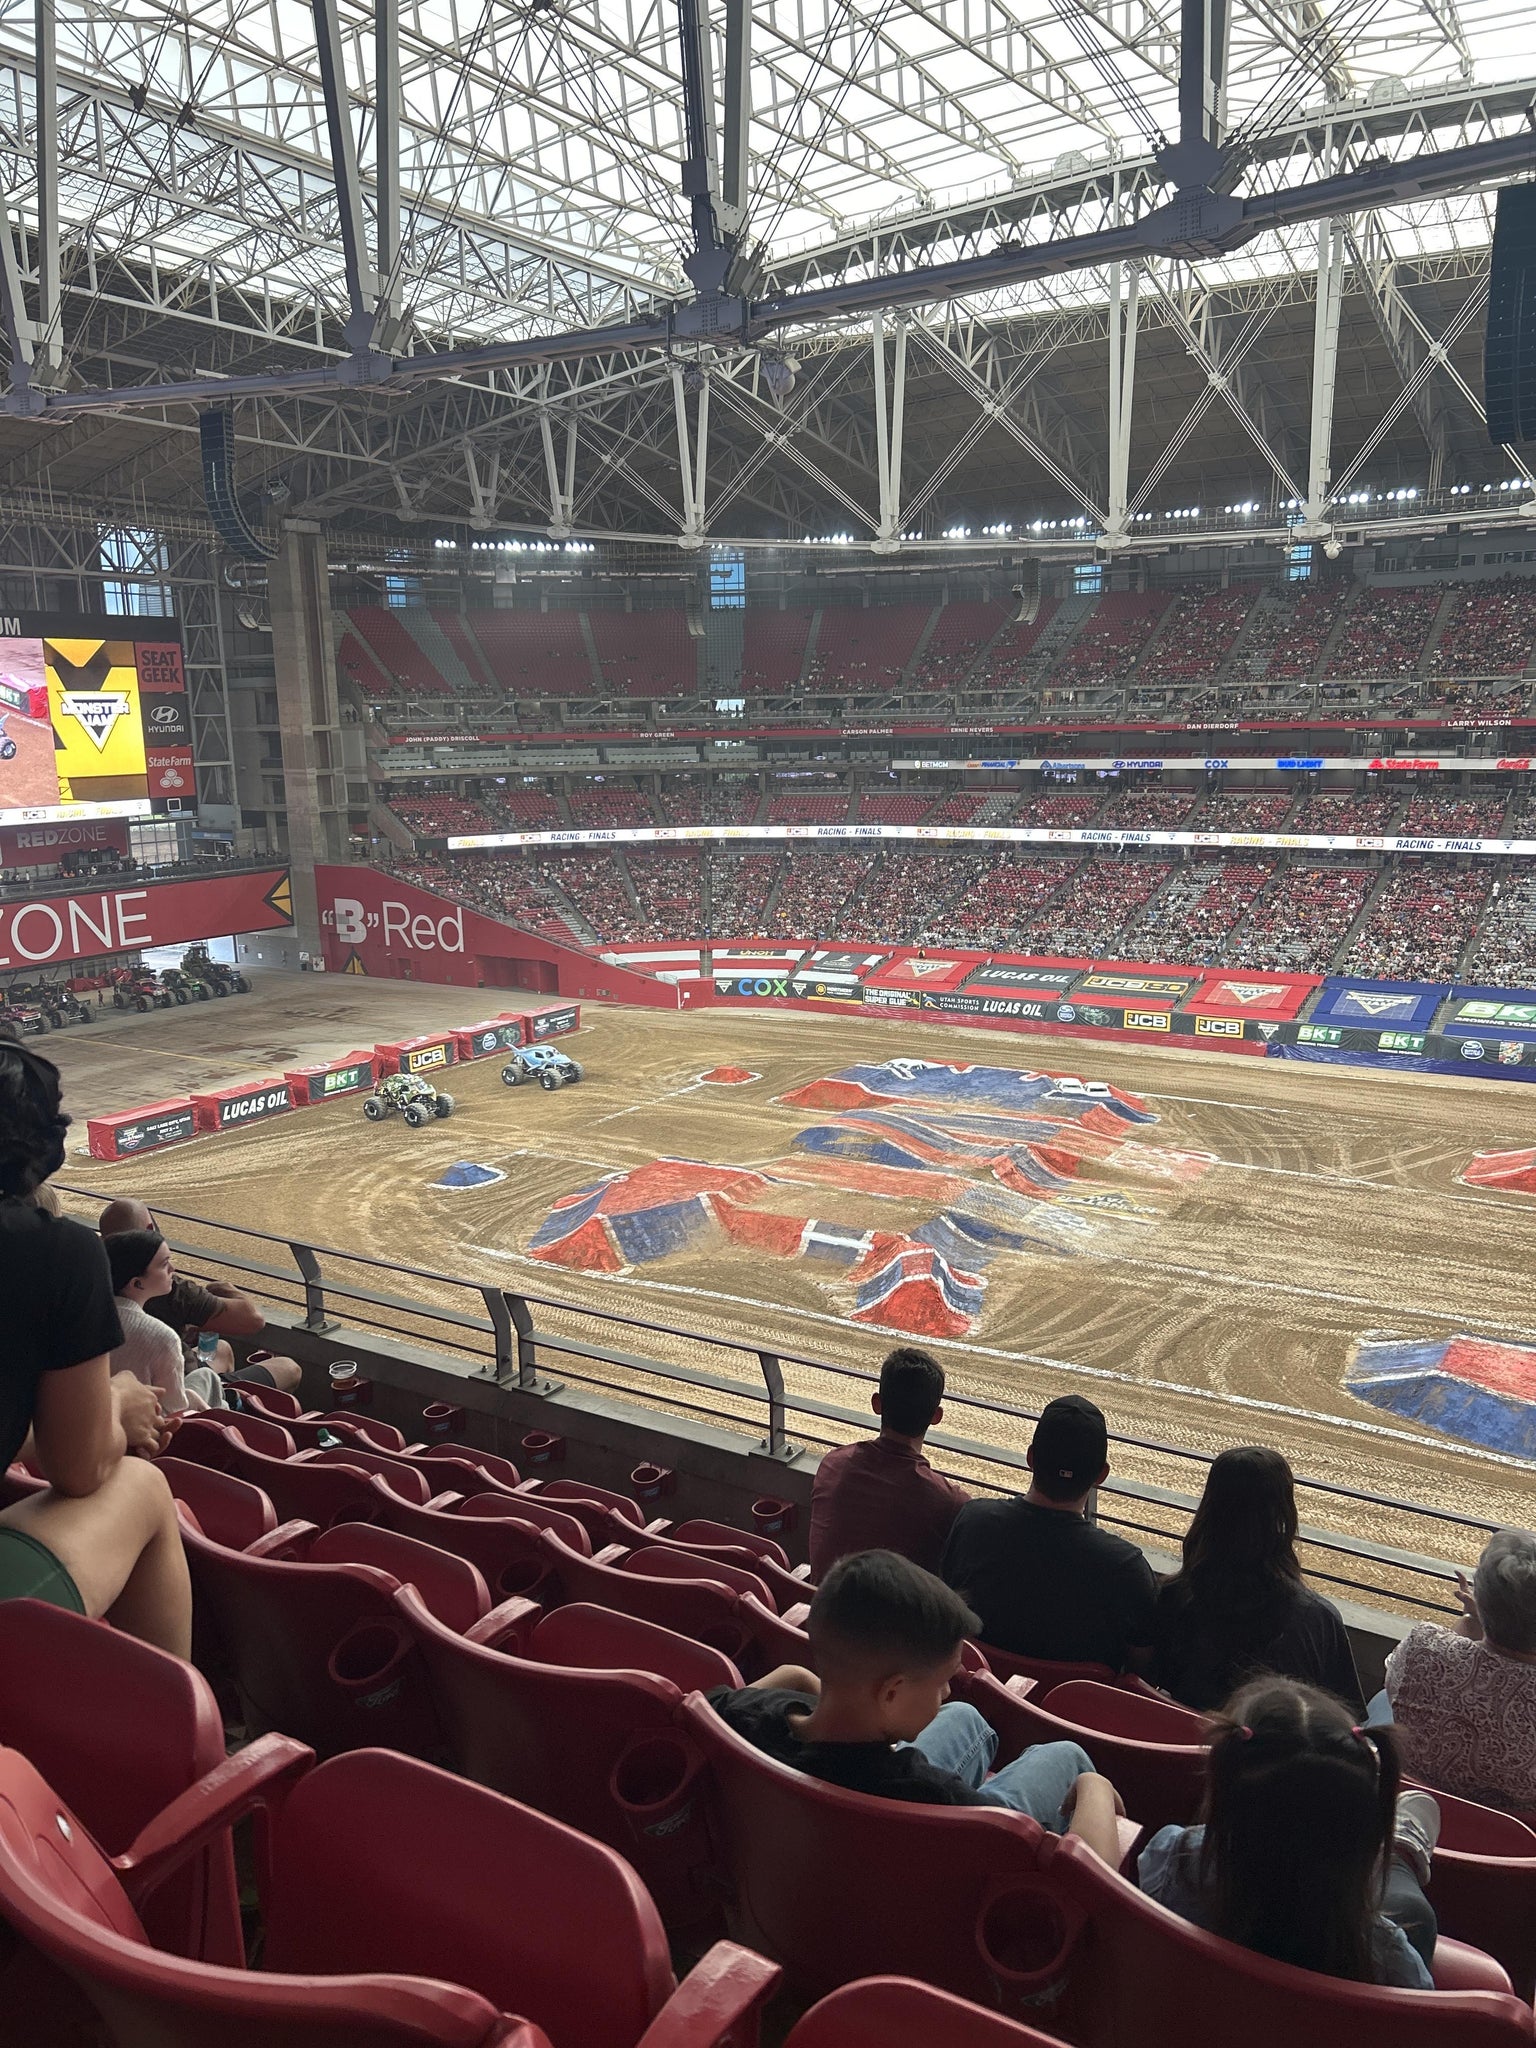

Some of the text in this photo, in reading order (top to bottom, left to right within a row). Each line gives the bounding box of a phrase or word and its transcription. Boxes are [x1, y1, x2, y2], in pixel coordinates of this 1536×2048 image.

[142, 650, 176, 666] SEAT
[142, 667, 180, 684] GEEK
[62, 702, 130, 715] MONSTER
[148, 725, 185, 733] HYUNDAI
[149, 756, 191, 767] State Farm
[1204, 760, 1229, 769] COX
[1386, 760, 1439, 769] State Farm
[550, 833, 580, 841] RACING
[588, 832, 616, 840] FINALS
[817, 828, 847, 836] RACING
[854, 828, 882, 836] FINALS
[1081, 832, 1112, 841] RACING
[1121, 832, 1151, 842] FINALS
[1230, 836, 1310, 846] RACING FINALS
[1396, 839, 1434, 849] RACING
[1445, 841, 1482, 851] FINALS
[382, 901, 465, 953] Red
[980, 969, 1071, 984] LUCAS OIL
[738, 979, 787, 997] COX
[1091, 977, 1144, 990] JCB
[1221, 983, 1283, 994] MONSTER
[865, 988, 911, 998] THE ORIGINAL
[865, 995, 907, 1006] SUPER GLUE
[940, 996, 980, 1006] UTAH SPORTS
[1345, 994, 1412, 1005] MONSTER
[939, 1002, 980, 1011] COMMISSION
[982, 1000, 1020, 1016] LUCAS
[1021, 1004, 1043, 1017] OIL
[1127, 1013, 1168, 1028] JCB
[1199, 1019, 1240, 1034] JCB
[1454, 1016, 1505, 1026] GROWING
[1298, 1026, 1341, 1042] BKT
[1378, 1033, 1424, 1049] BKT
[413, 1050, 444, 1068] JCB
[325, 1070, 358, 1091] BKT
[223, 1090, 289, 1121] LUCAS OIL
